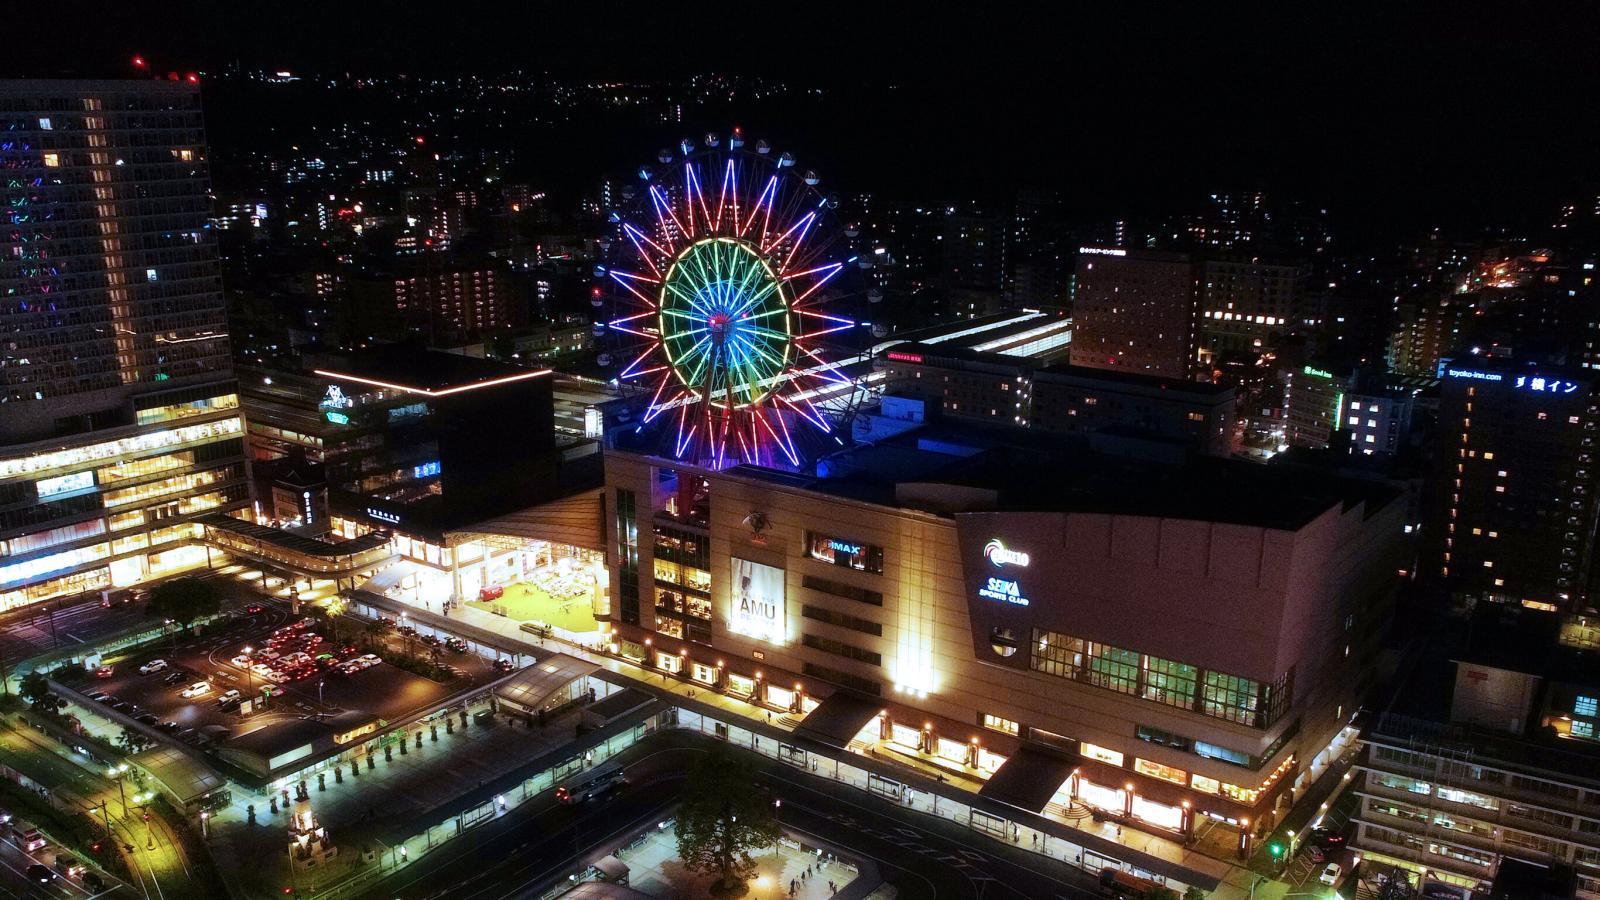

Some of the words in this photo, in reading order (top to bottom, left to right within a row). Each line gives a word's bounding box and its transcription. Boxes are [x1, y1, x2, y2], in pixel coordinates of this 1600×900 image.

[1449, 369, 1502, 381] toyoko-inn.com
[831, 541, 861, 555] IMAX
[987, 577, 1020, 597] SEIKA
[979, 588, 1007, 601] SPORTS
[1008, 595, 1030, 606] CLUB
[740, 597, 775, 620] AMU
